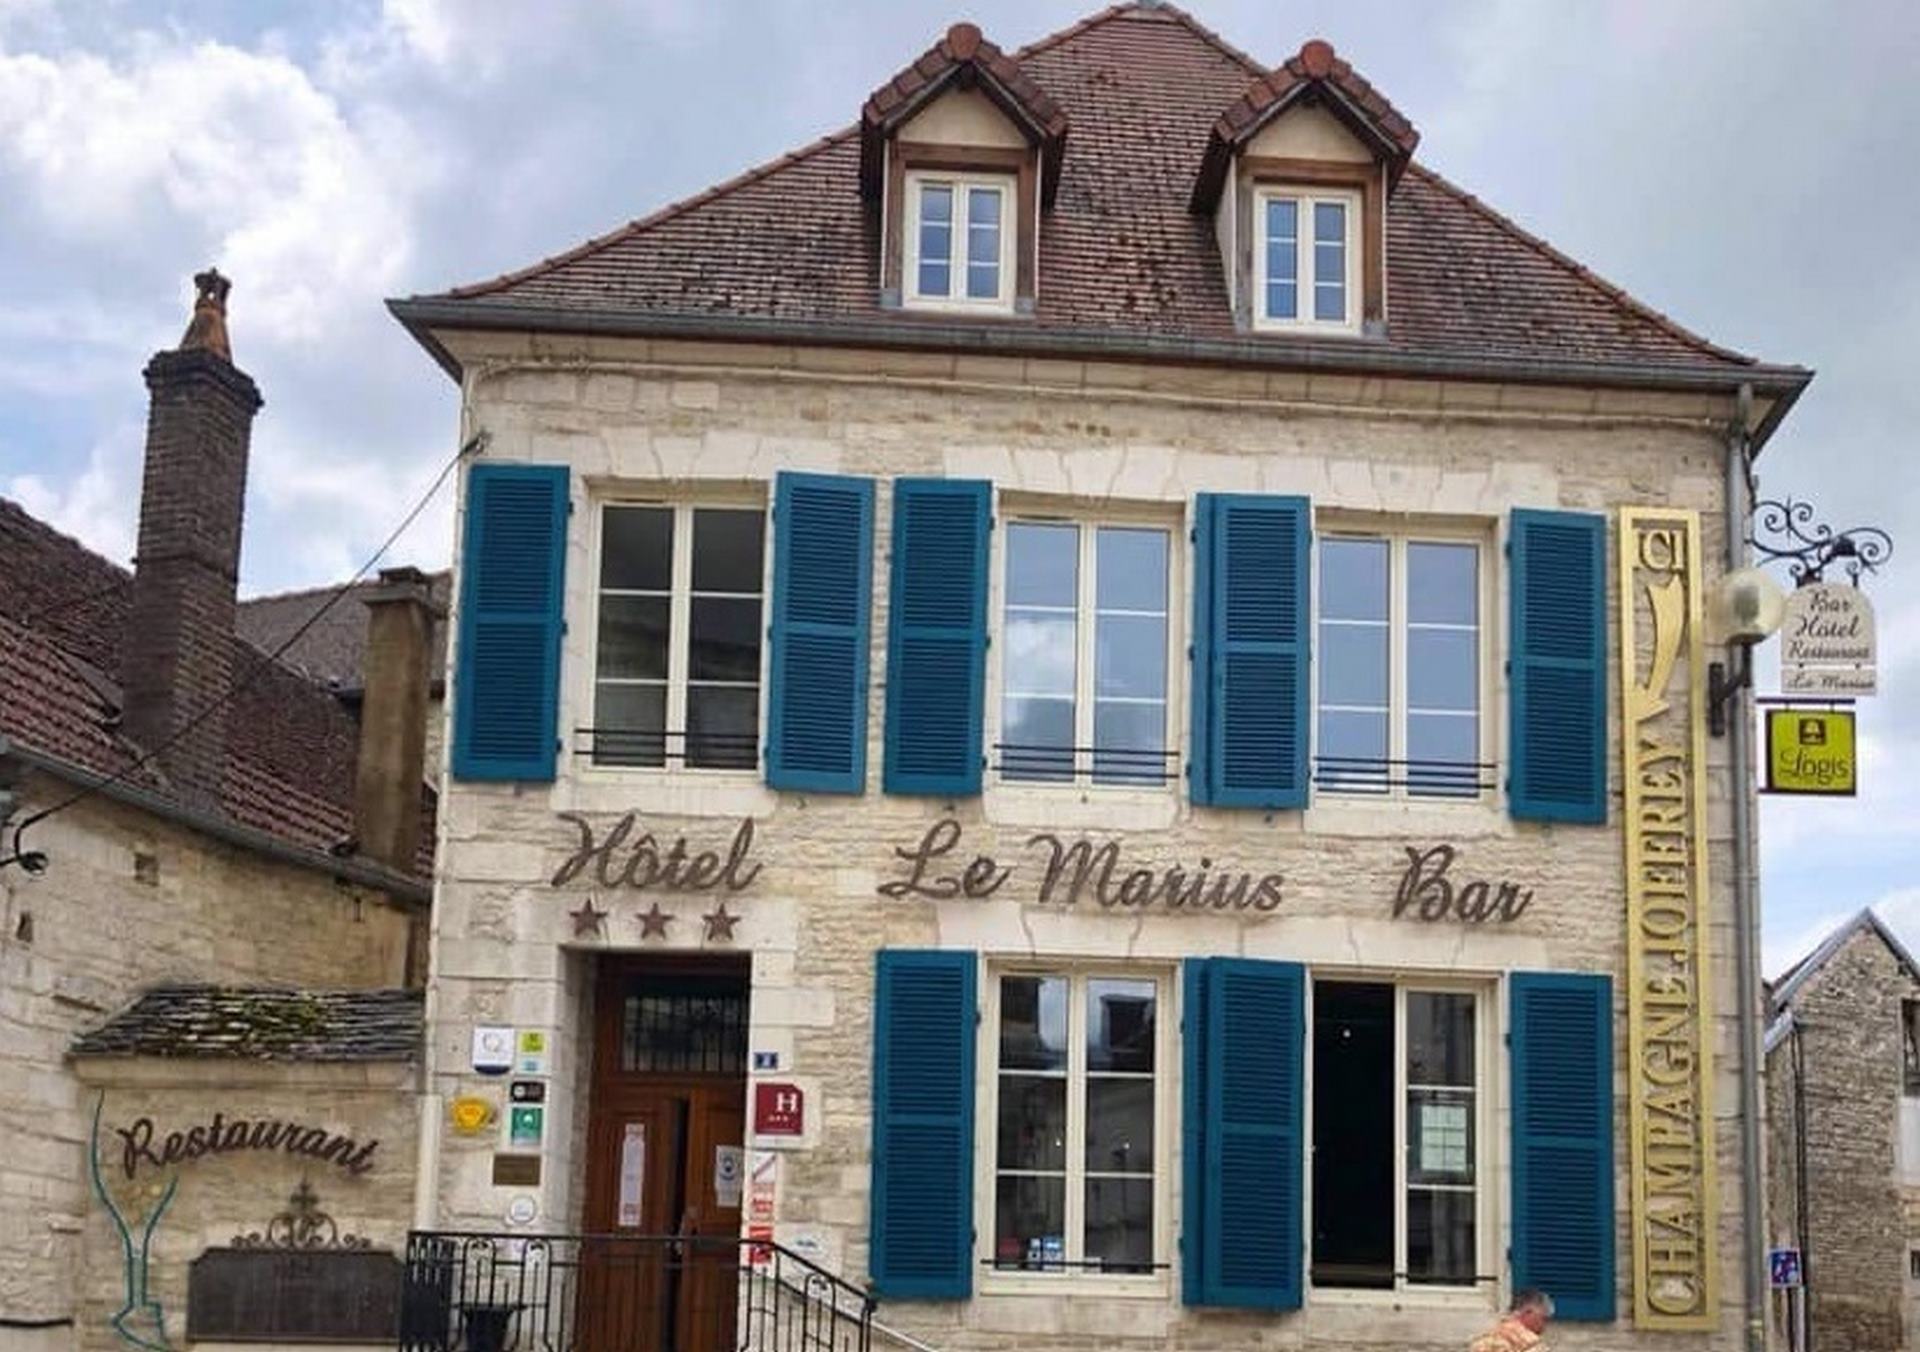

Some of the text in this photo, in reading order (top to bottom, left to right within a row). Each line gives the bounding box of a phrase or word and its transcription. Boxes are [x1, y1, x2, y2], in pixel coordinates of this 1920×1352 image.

[1807, 588, 1850, 612] Bar
[551, 812, 763, 891] Hôtel
[877, 819, 1284, 912] Le Marius
[1393, 844, 1534, 922] Bar
[776, 1092, 798, 1113] H
[117, 1112, 379, 1180] Restaurant
[1641, 977, 1697, 1316] CHAMPAGNE
